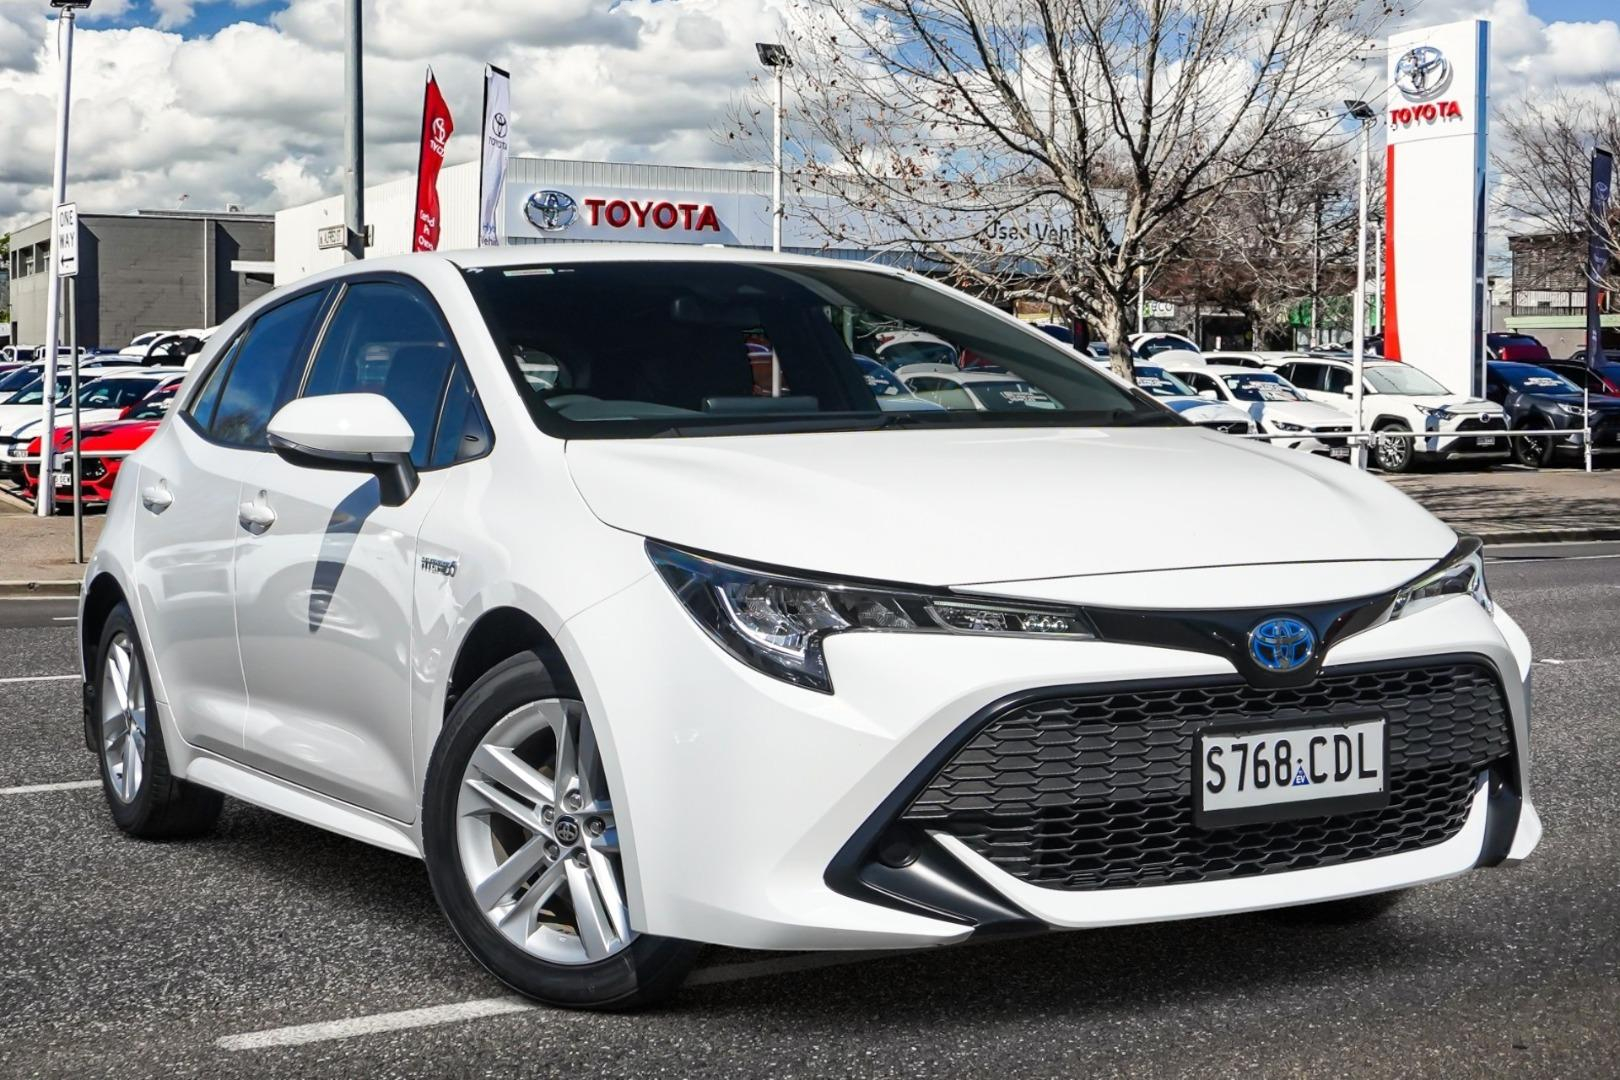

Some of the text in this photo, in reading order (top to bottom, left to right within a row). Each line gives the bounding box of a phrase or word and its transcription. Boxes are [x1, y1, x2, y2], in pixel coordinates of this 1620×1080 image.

[1389, 101, 1462, 125] TOYOTA
[60, 211, 74, 227] ONE
[585, 199, 720, 232] TOYOTA
[59, 232, 75, 248] WAY
[987, 222, 1030, 240] Used
